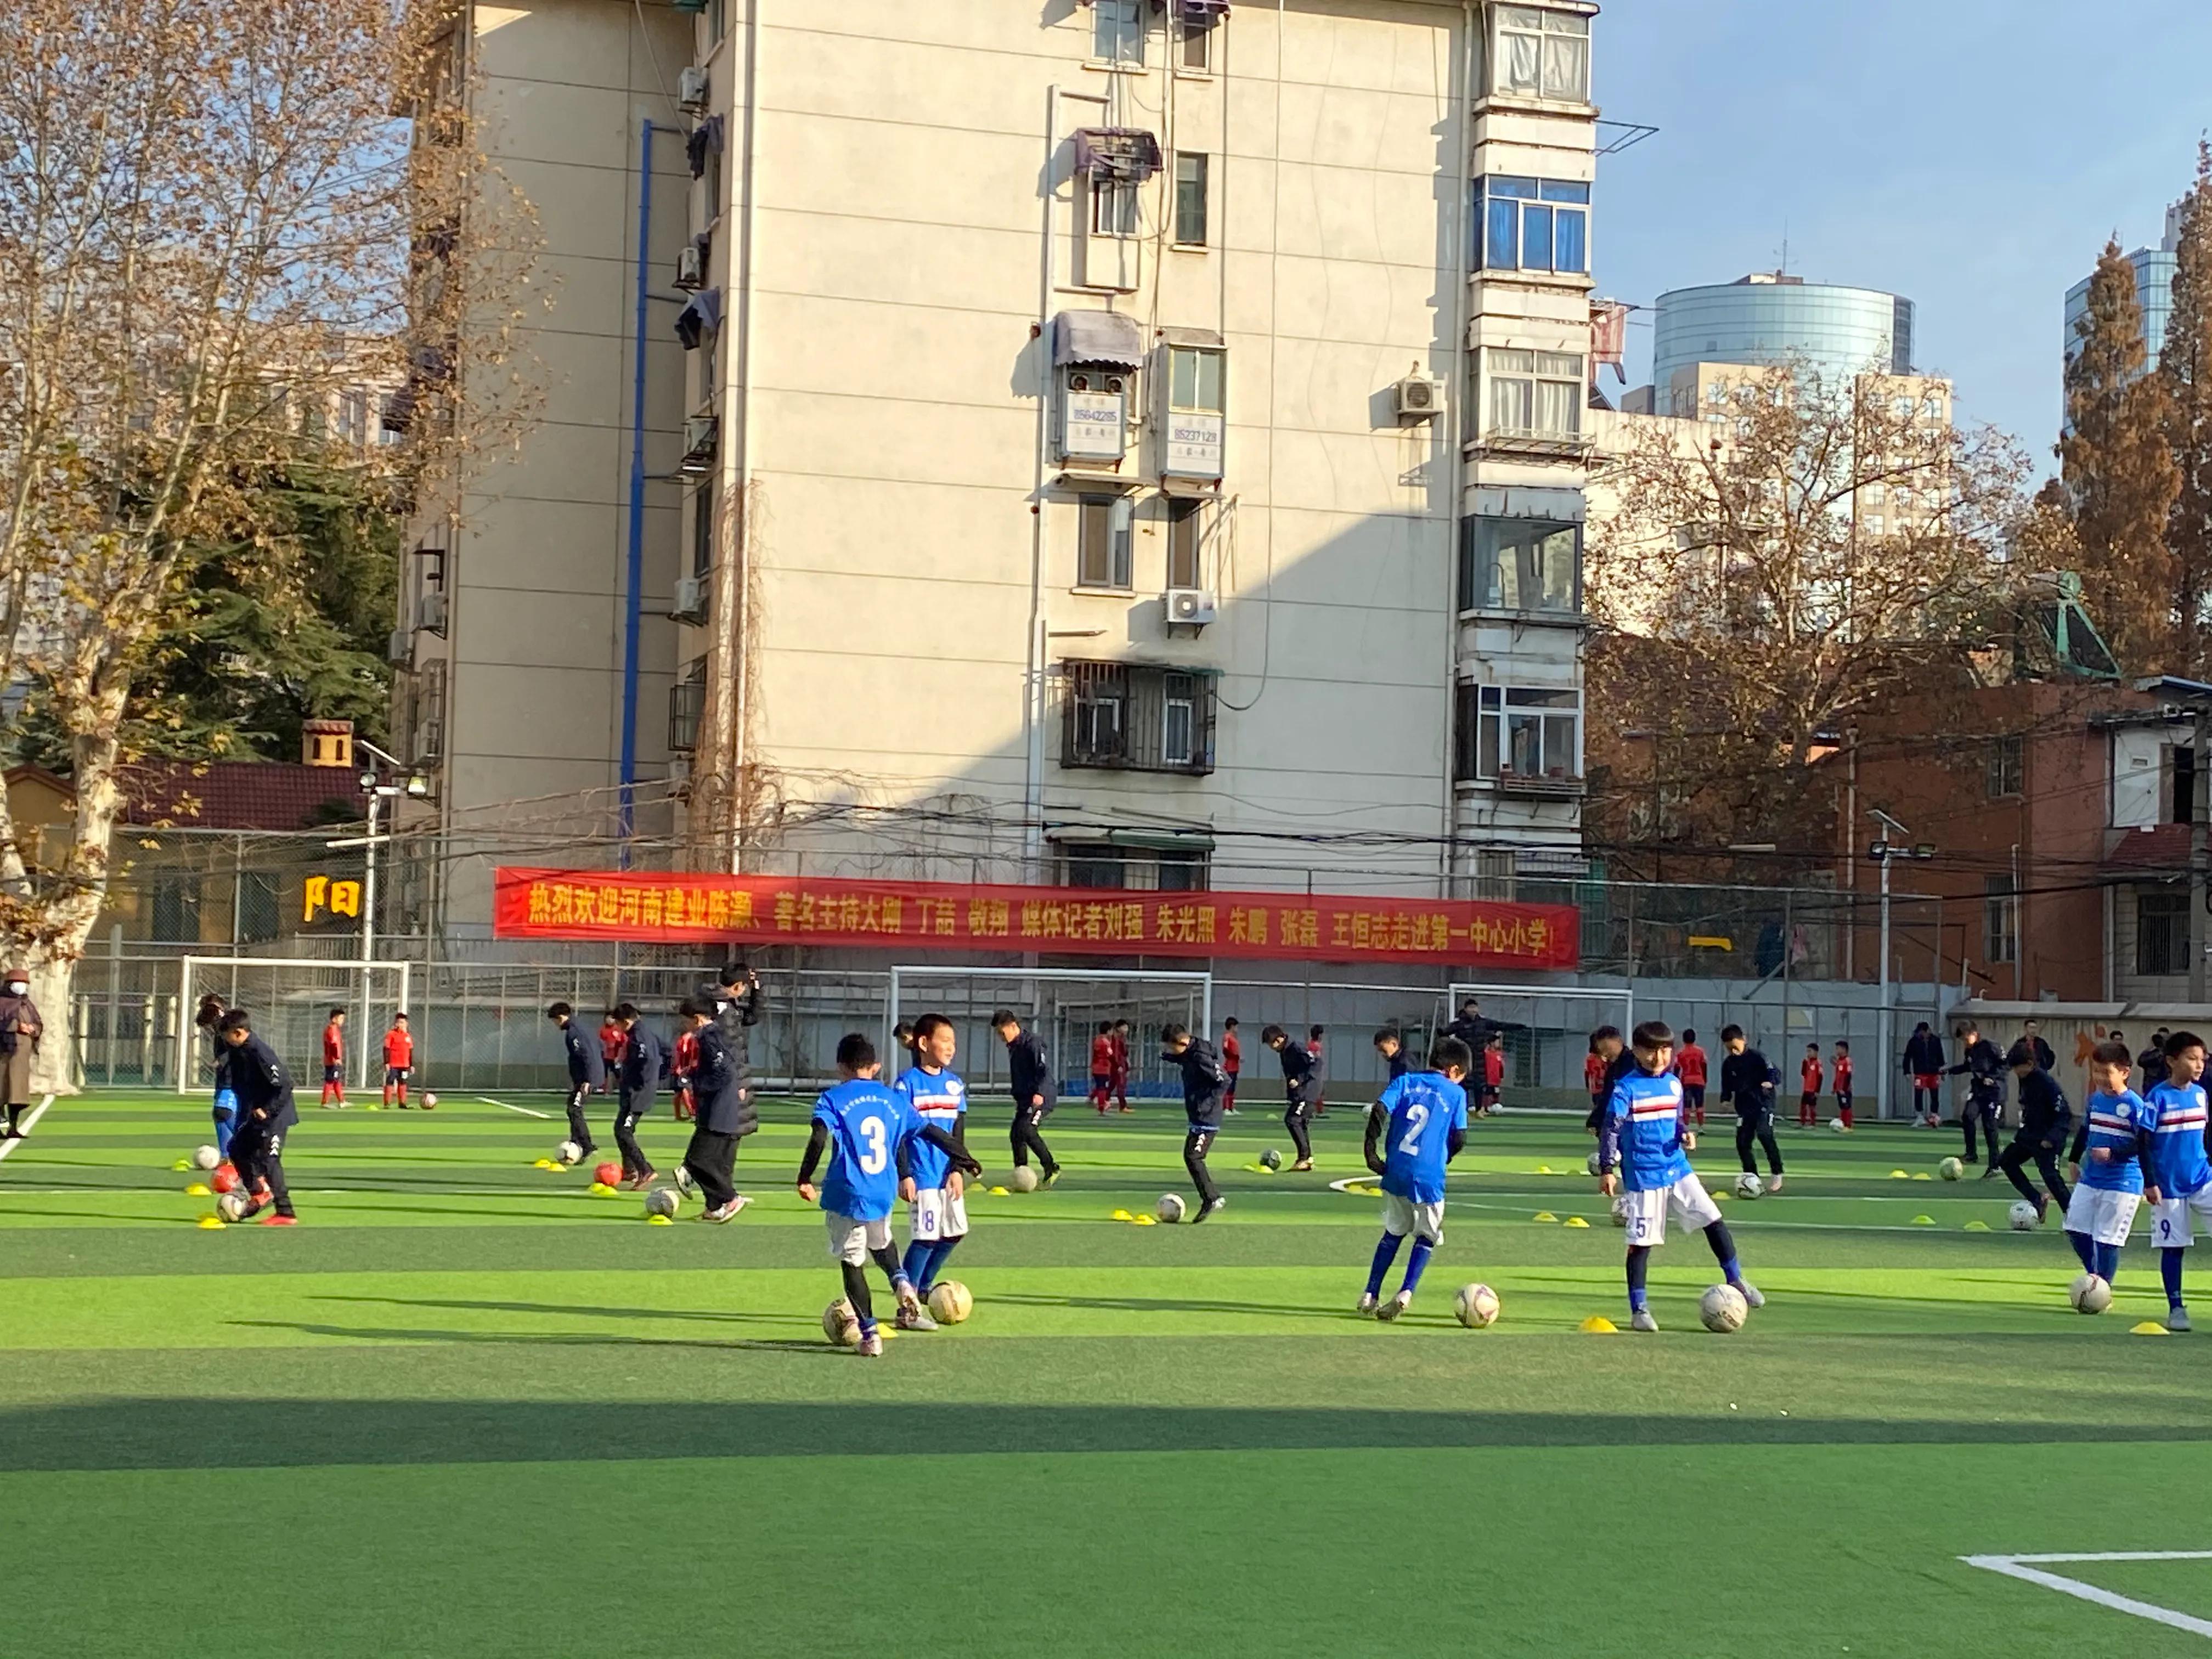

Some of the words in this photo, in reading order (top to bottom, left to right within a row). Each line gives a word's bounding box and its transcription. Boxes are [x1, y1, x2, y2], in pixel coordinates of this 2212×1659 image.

[1020, 899, 1144, 940] 媒体记者刘强
[1156, 903, 1216, 943] 朱光照
[1228, 907, 1267, 945] 朱鹏
[1280, 909, 1319, 947] 张磊
[860, 1116, 887, 1175] 3
[1399, 1104, 1429, 1156] 2
[925, 1210, 934, 1232] 8
[2160, 1219, 2171, 1240] 9
